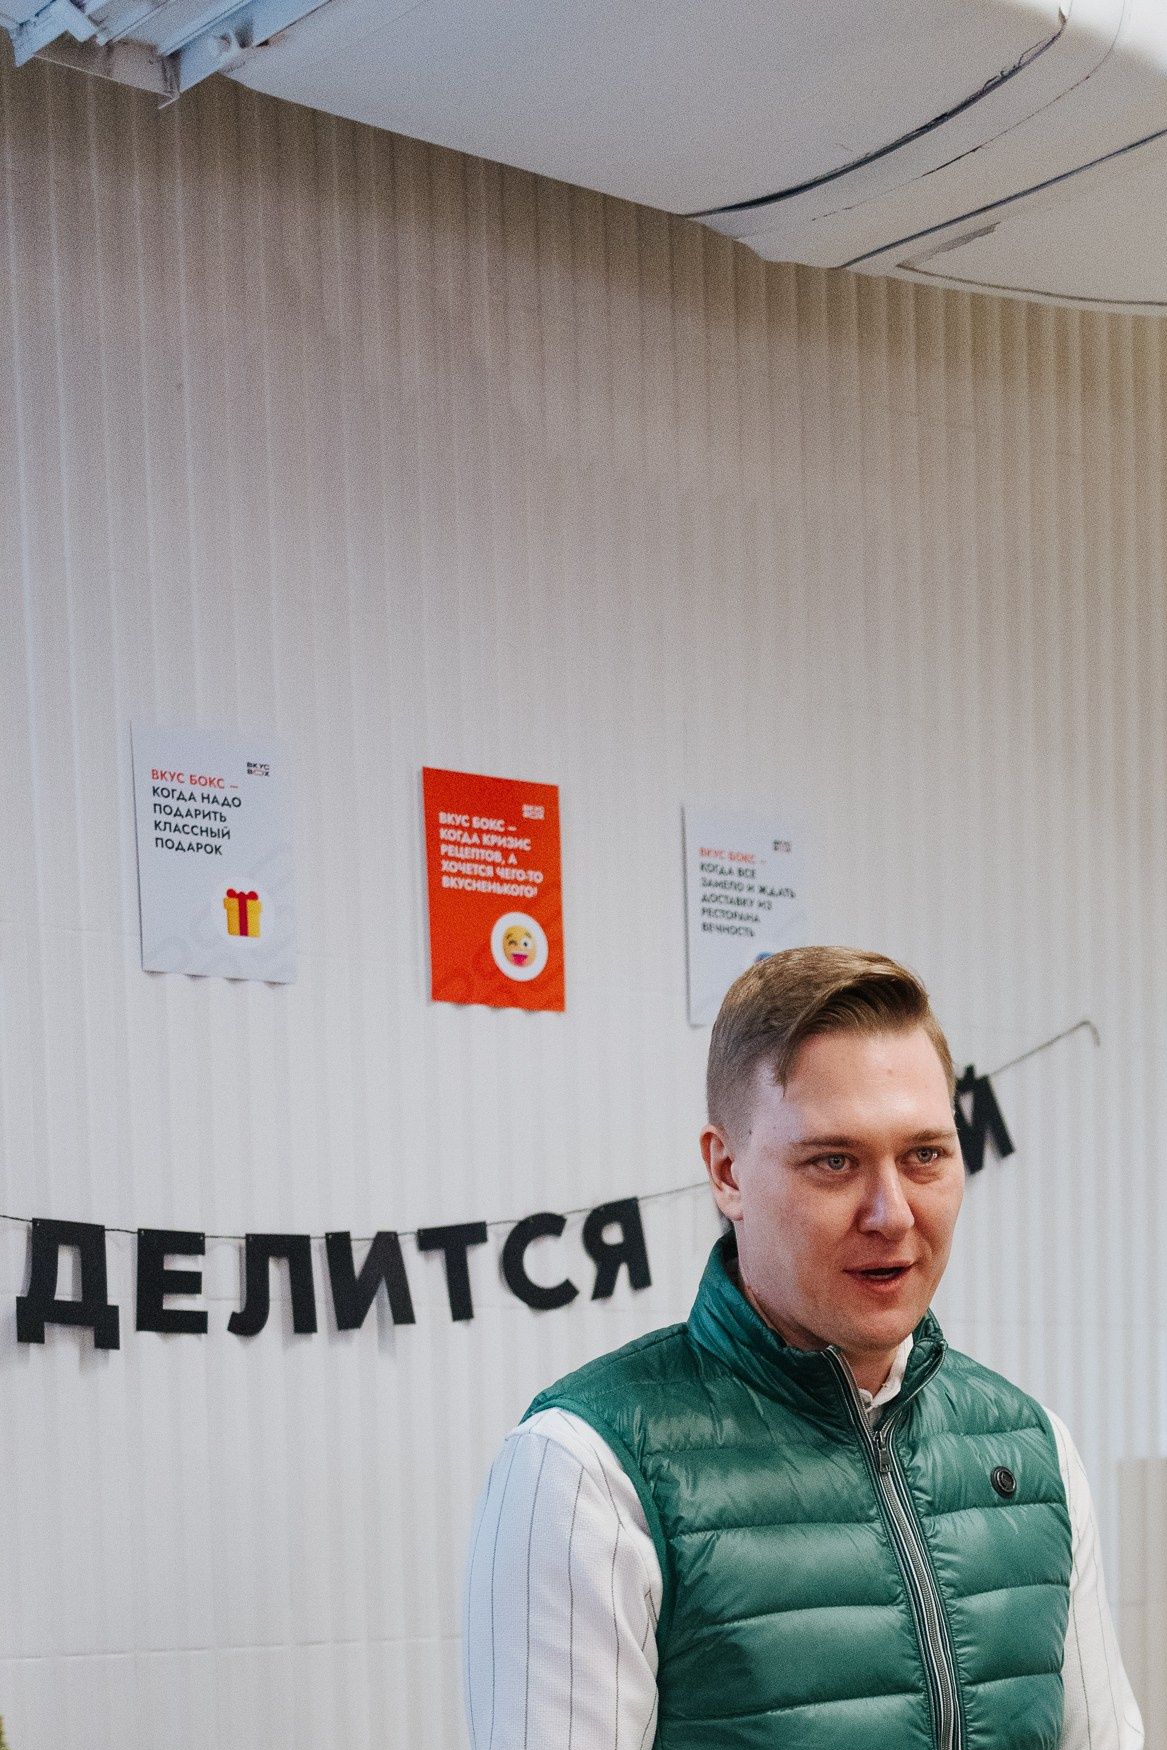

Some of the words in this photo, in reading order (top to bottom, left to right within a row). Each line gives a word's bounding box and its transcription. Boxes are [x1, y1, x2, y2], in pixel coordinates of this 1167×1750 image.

[151, 768, 185, 783] ВКУС
[189, 774, 225, 788] БОКС
[152, 786, 197, 802] КОГДА
[201, 792, 241, 807] НАДО
[153, 803, 227, 822] ПОДАРИТЬ
[438, 811, 469, 827] ВКУС
[471, 816, 504, 831] БОКС
[154, 820, 231, 839] КЛАССНЫЙ
[439, 827, 479, 844] КОГДА
[481, 833, 531, 850] КРИЗИС
[155, 837, 223, 855] ПОДАРОК
[440, 843, 505, 865] РЕЦЕПТОВ,
[507, 852, 518, 865] А
[441, 859, 494, 877] ХОЧЕТСЯ
[496, 866, 543, 883] ЧЕГО-ТО
[16, 1197, 652, 1350] ДЕЛИТСЯ
